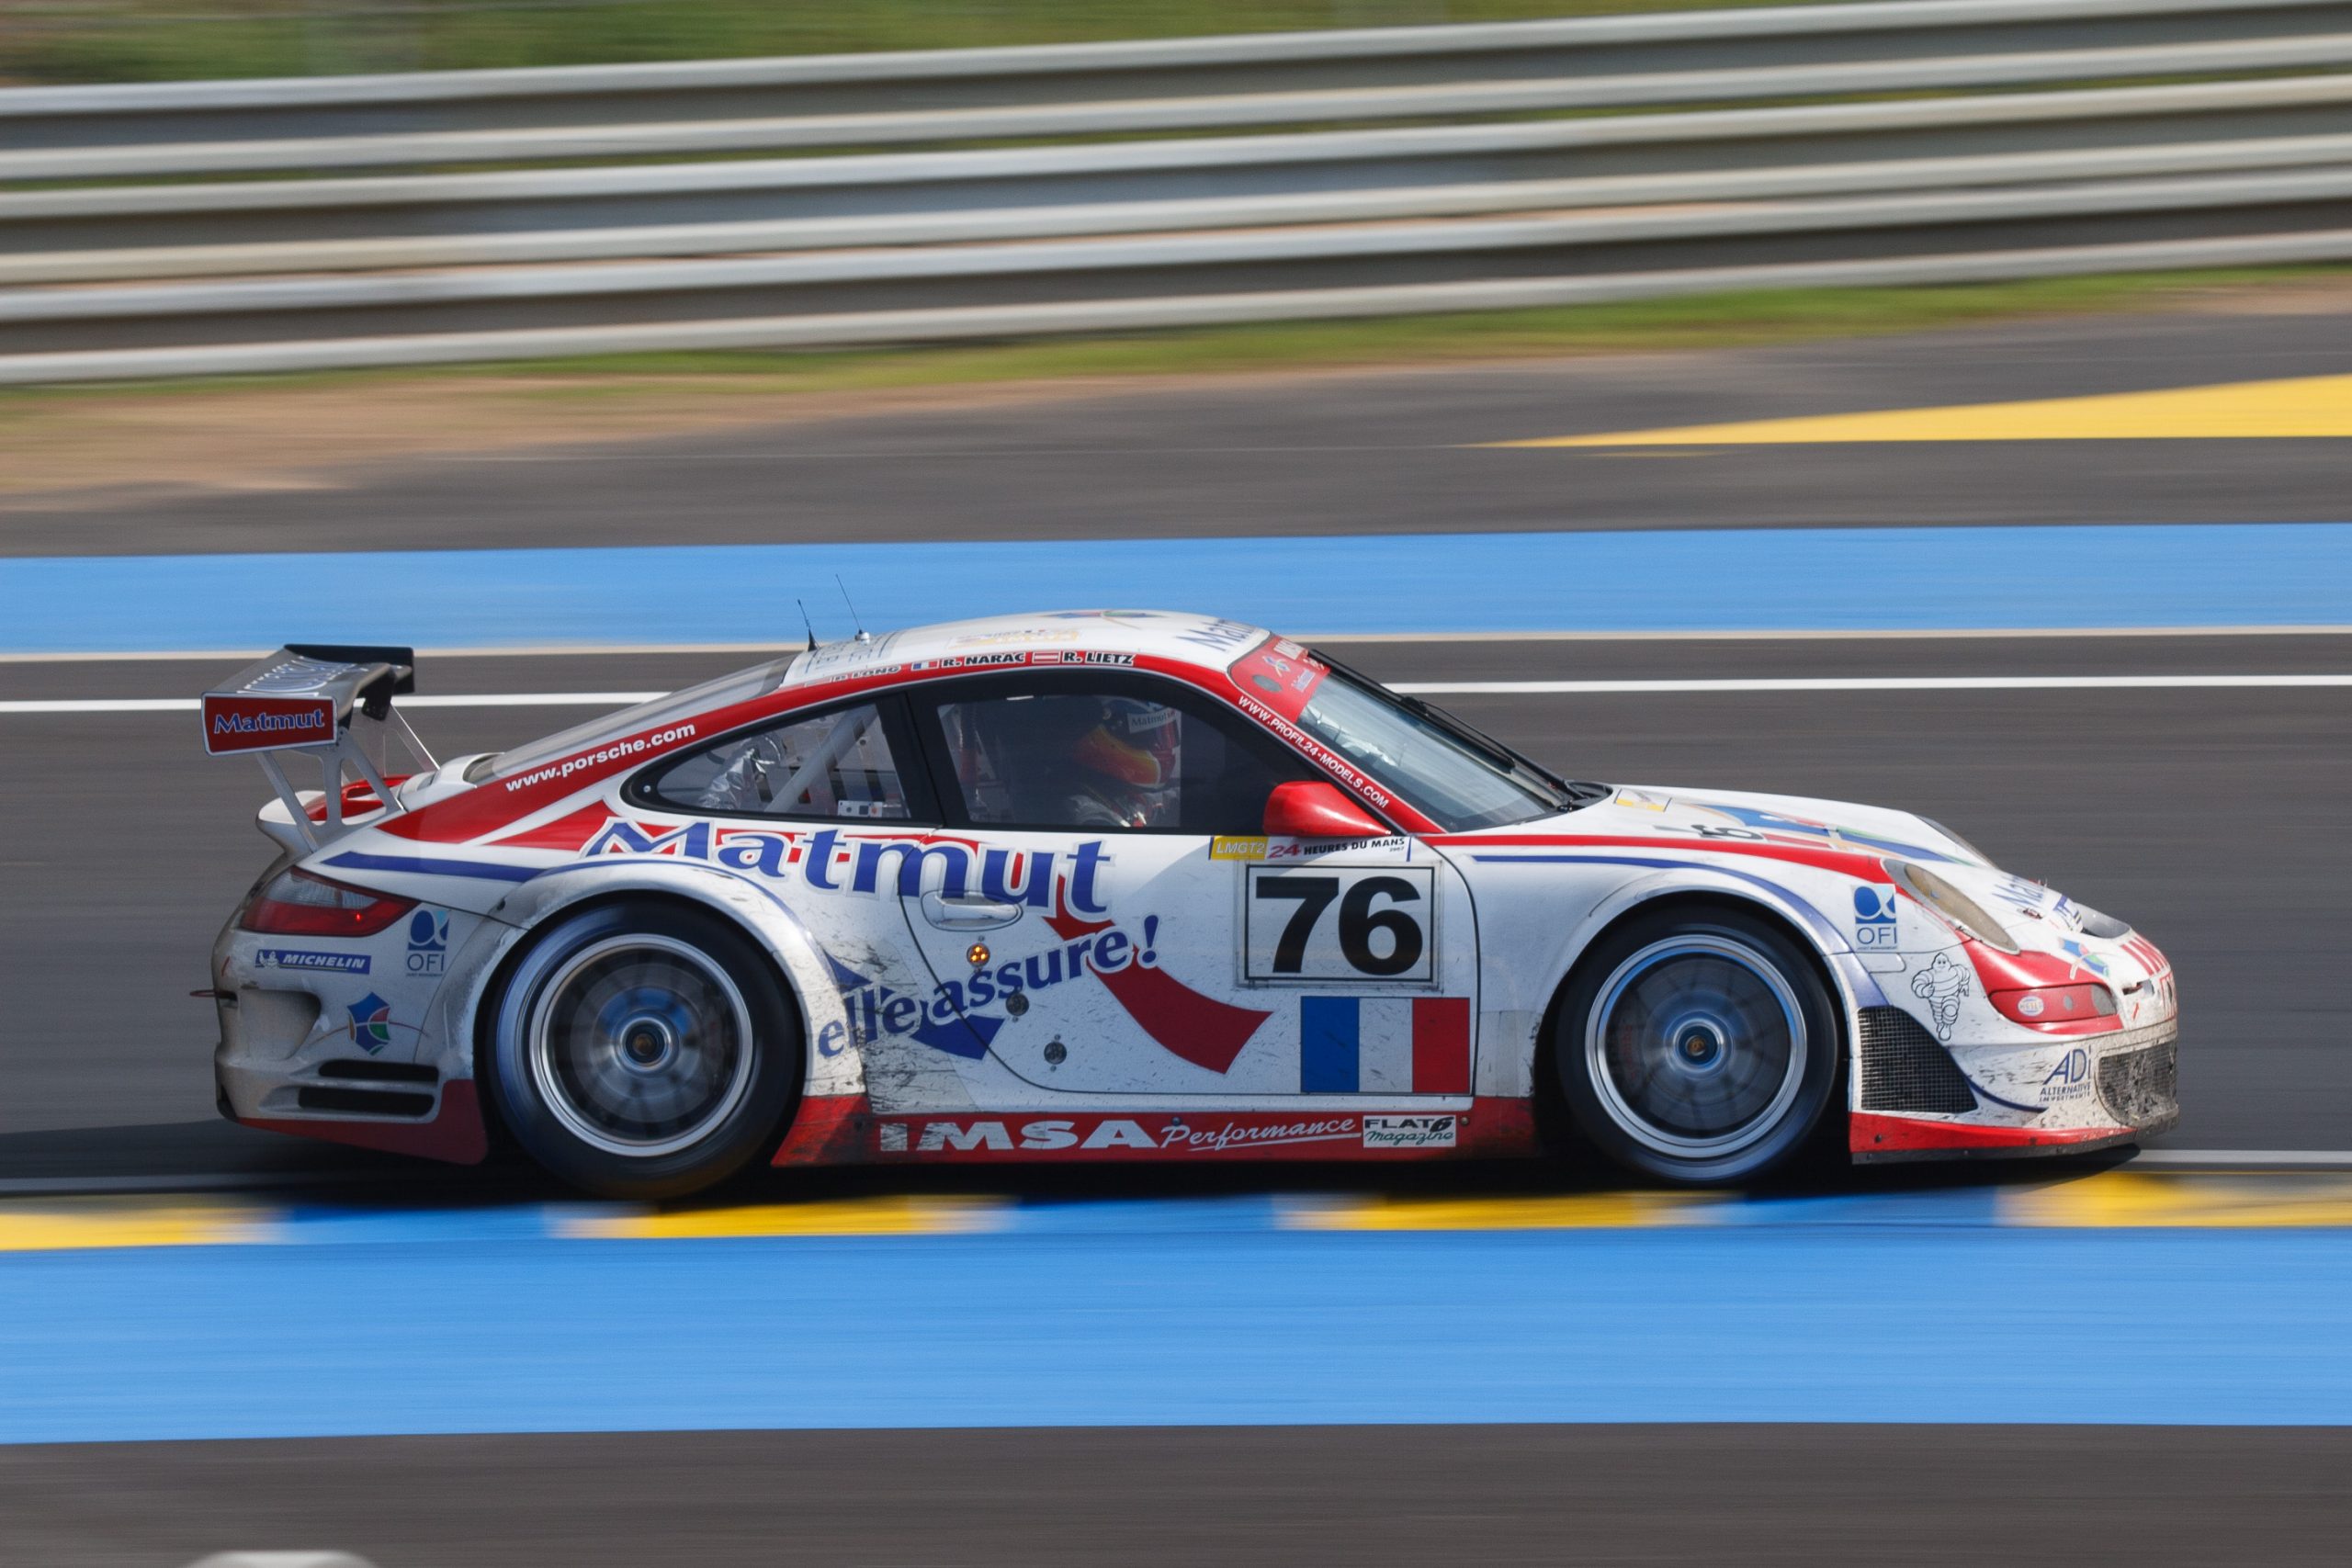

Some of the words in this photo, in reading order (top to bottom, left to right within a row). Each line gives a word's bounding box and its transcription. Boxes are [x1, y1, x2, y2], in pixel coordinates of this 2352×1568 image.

[943, 658, 962, 668] R.
[966, 651, 1025, 666] NARAC
[1063, 651, 1083, 663] R.
[1086, 652, 1136, 665] LIETZ
[213, 708, 325, 735] Matmut
[505, 723, 697, 793] www.porsche.com
[1238, 694, 1390, 809] WWW.PROFIL24-MODELS.COM
[1216, 840, 1266, 855] LMGT2
[1268, 842, 1302, 860] 24
[1303, 840, 1348, 856] HEURES
[1351, 838, 1368, 851] DU
[1371, 837, 1405, 849] MANS
[580, 819, 1114, 917] Matmut
[1255, 875, 1423, 975] 76
[1856, 927, 1898, 945] OFI
[282, 953, 366, 969] MICHELIN
[406, 953, 445, 972] OFI
[879, 1119, 1159, 1152] IMSA
[1159, 1118, 1357, 1151] Performance
